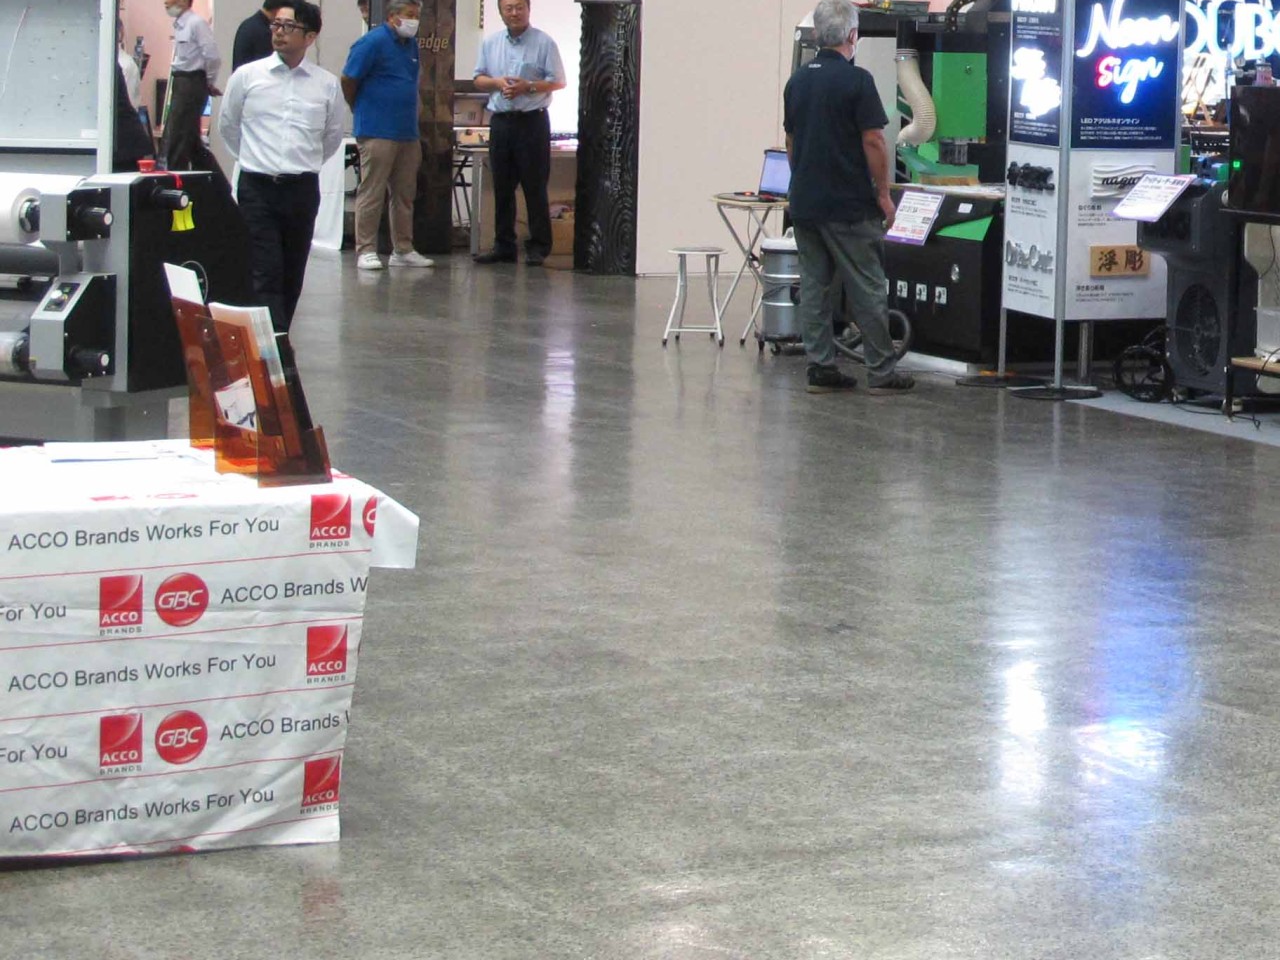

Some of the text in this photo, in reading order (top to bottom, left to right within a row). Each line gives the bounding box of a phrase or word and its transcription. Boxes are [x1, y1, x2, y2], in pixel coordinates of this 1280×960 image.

[1098, 249, 1145, 272] 浮彫
[8, 517, 279, 551] ACCO Brands Works For You
[311, 526, 347, 539] ACCO
[309, 541, 350, 549] BRANDS
[221, 584, 278, 604] ACCO
[284, 579, 345, 598] Brands
[158, 589, 204, 611] GBC
[30, 603, 67, 620] You
[101, 611, 139, 625] ACCO
[100, 626, 143, 636] BRANDS
[8, 653, 276, 692] ACCO Brands Works For You
[308, 660, 343, 673] ACCO
[307, 674, 346, 684] BRANDS
[219, 719, 275, 741] ACCO
[281, 713, 340, 733] Brands
[158, 726, 202, 748] GBC
[32, 744, 68, 760] You
[101, 750, 139, 764] ACCO
[100, 765, 142, 775] BRANDS
[303, 791, 335, 804] ACCO
[9, 788, 274, 833] ACCO Brands Works For You
[300, 804, 339, 815] BRANDS
